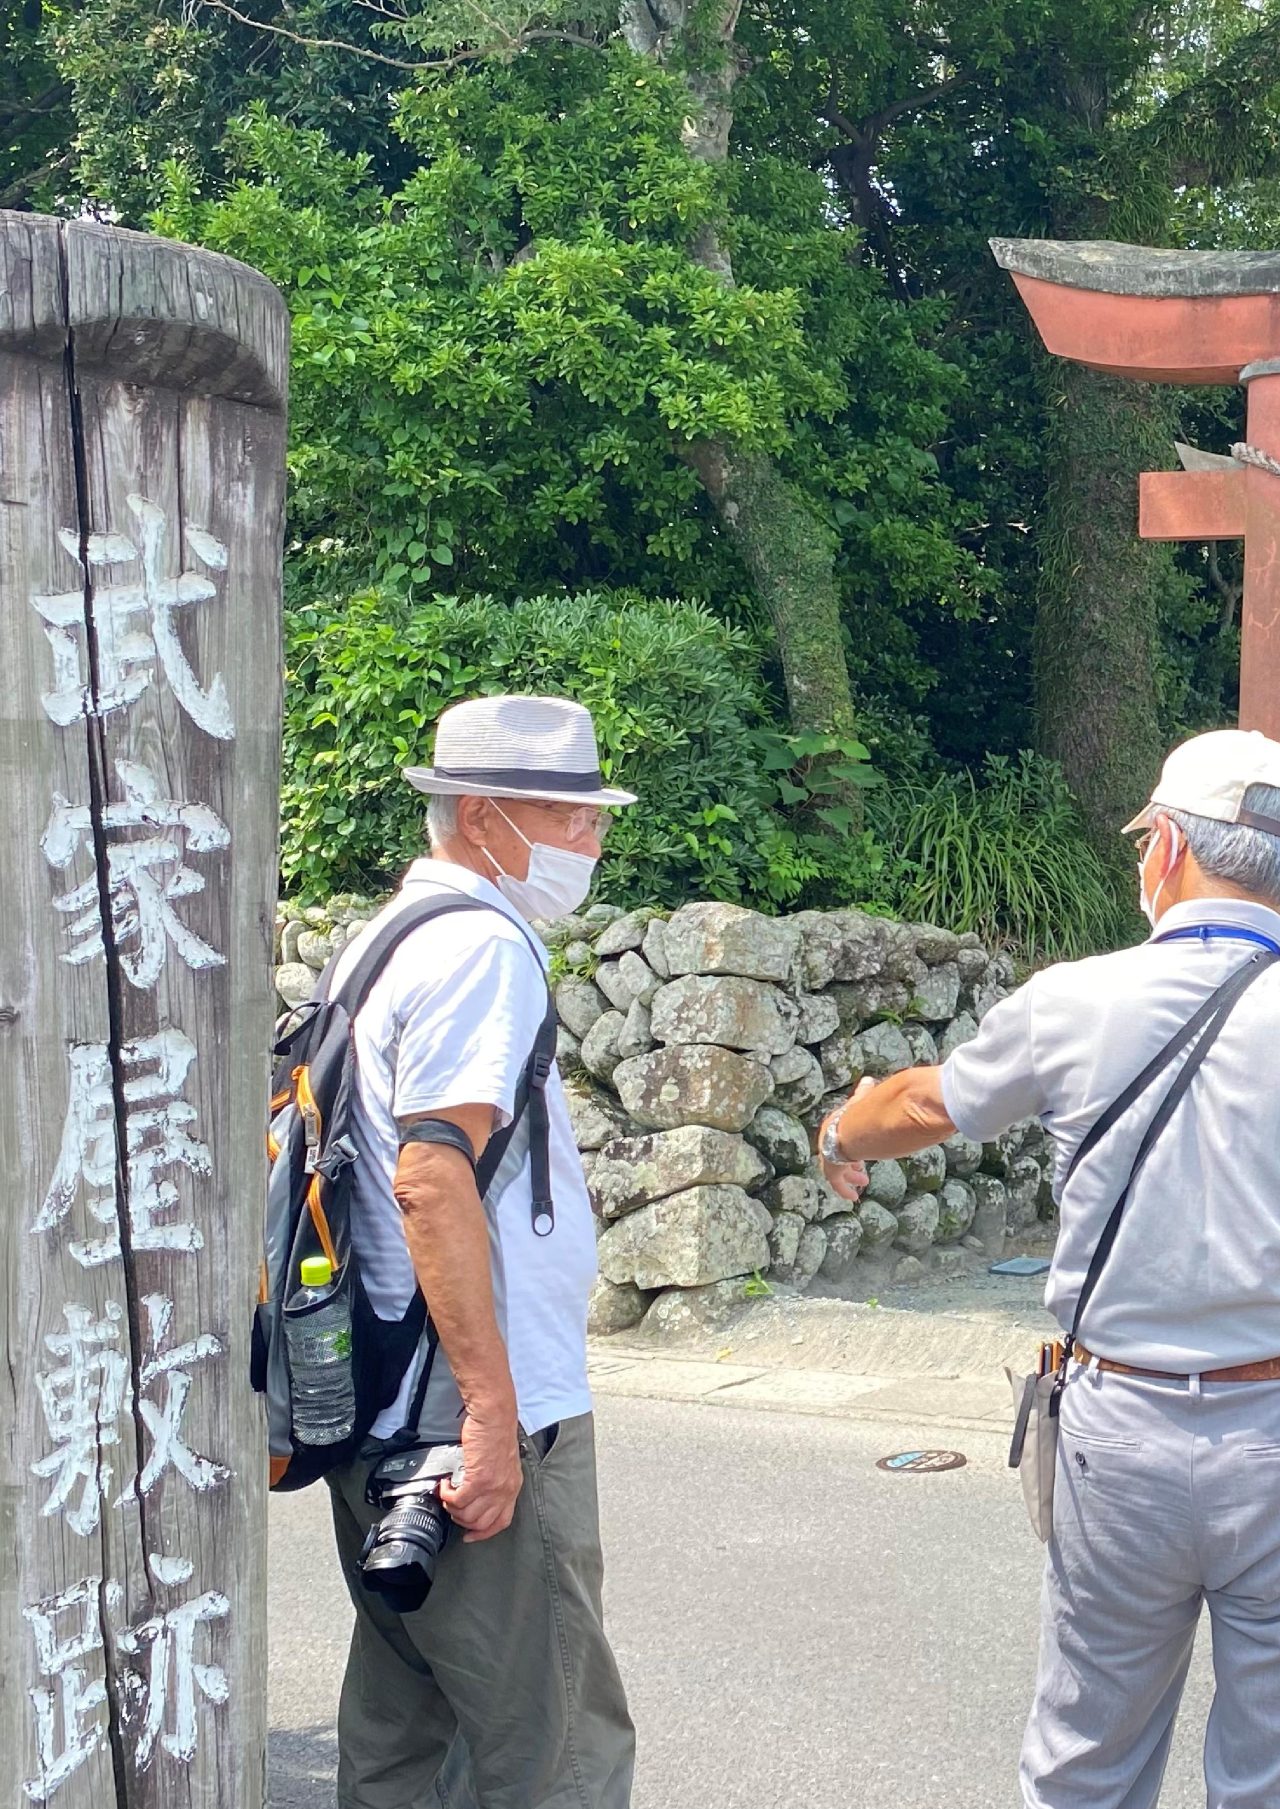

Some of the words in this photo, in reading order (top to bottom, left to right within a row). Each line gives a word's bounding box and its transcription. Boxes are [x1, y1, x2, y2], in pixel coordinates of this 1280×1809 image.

[22, 491, 237, 1804] 武家屋敷跡
